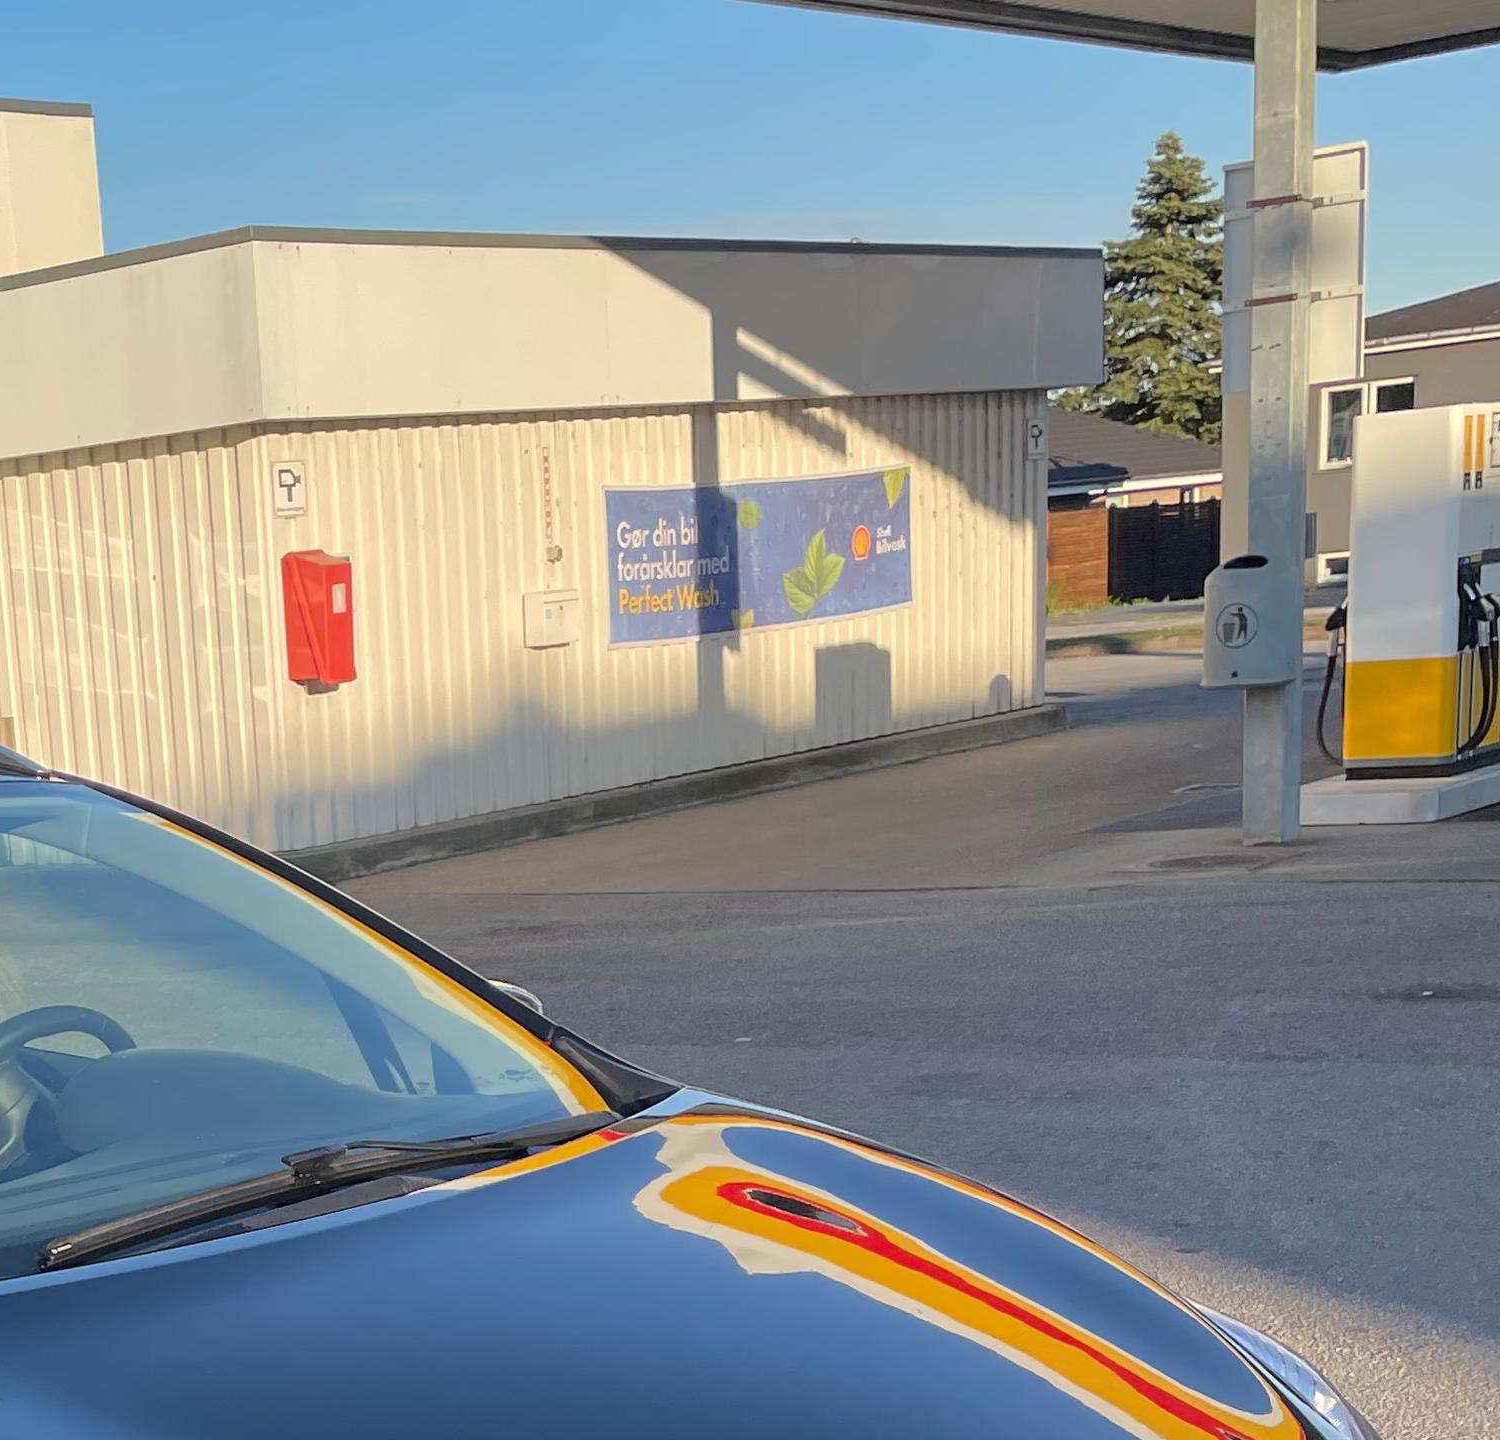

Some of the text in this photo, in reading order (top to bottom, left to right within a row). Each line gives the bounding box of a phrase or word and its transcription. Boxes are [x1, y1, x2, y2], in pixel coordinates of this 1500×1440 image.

[617, 516, 698, 549] Gør din bil
[617, 546, 730, 582] forårsklar med
[618, 580, 719, 615] Perfect Wash
